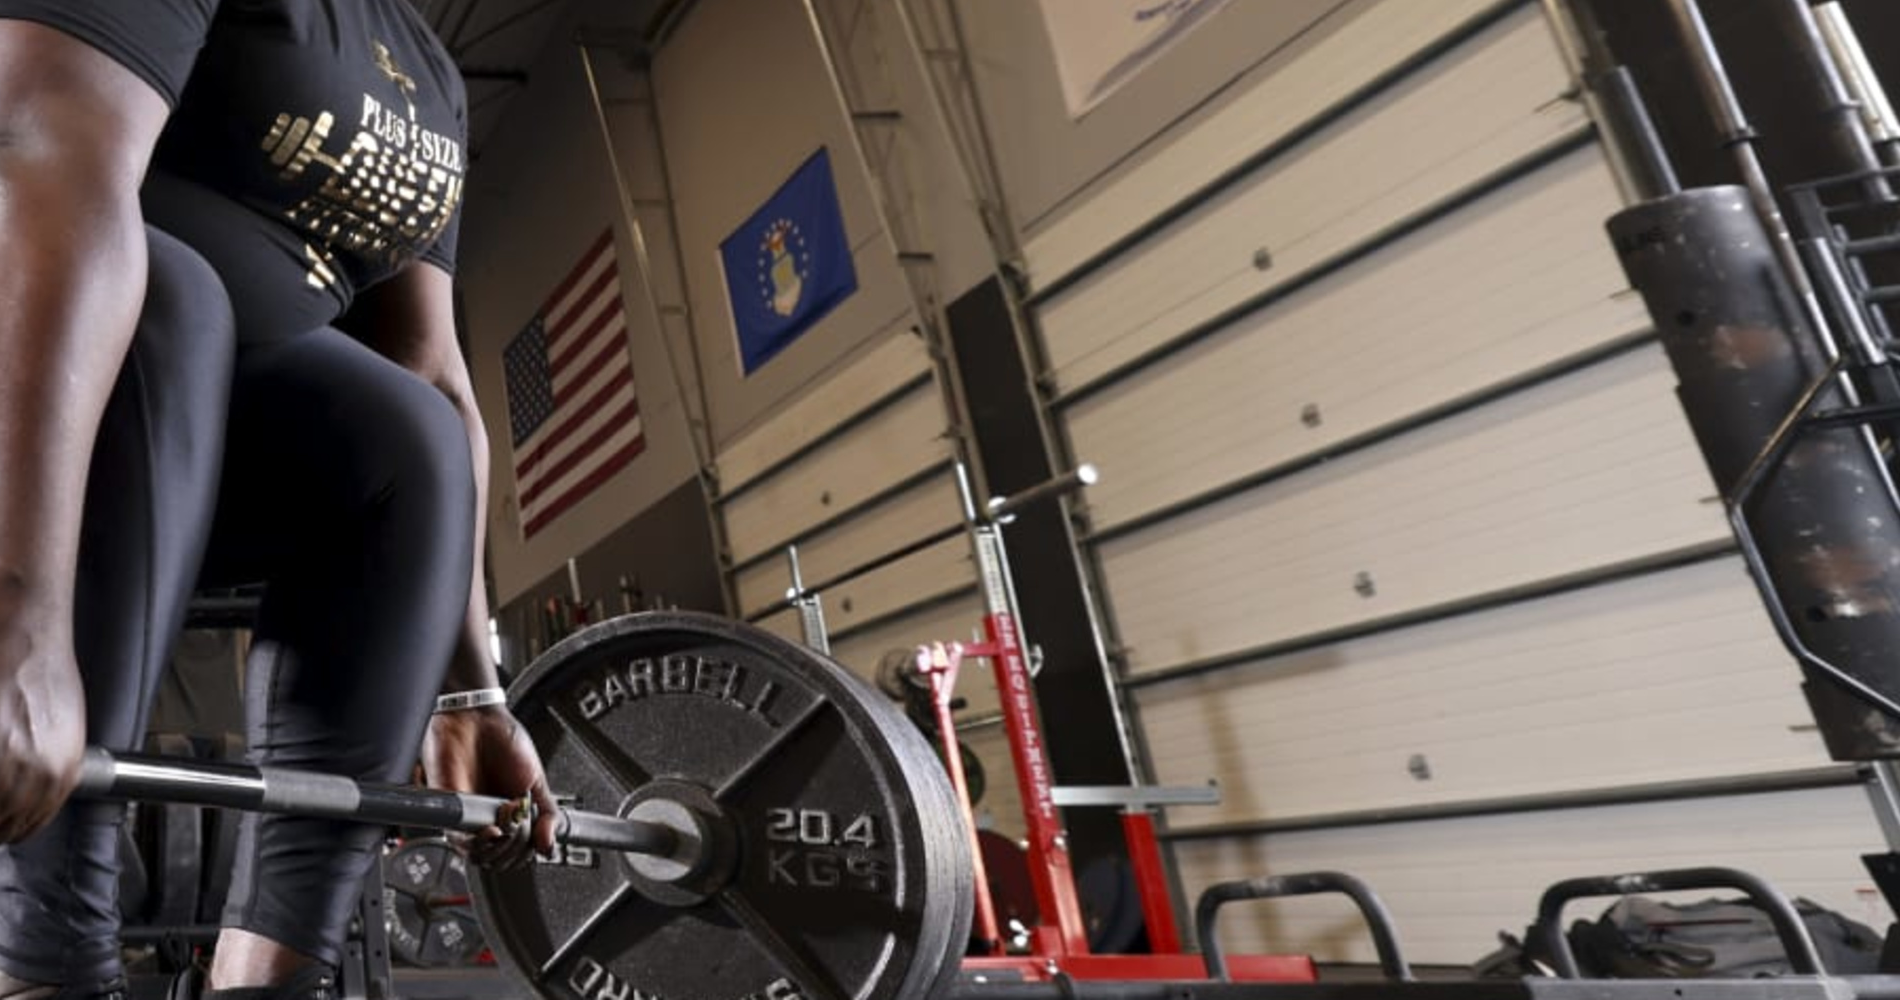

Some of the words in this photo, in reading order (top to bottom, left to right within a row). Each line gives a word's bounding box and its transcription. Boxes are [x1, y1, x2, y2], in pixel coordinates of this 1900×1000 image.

[360, 92, 407, 149] PLUS
[579, 655, 782, 728] BARBELL
[766, 807, 876, 849] 20.4
